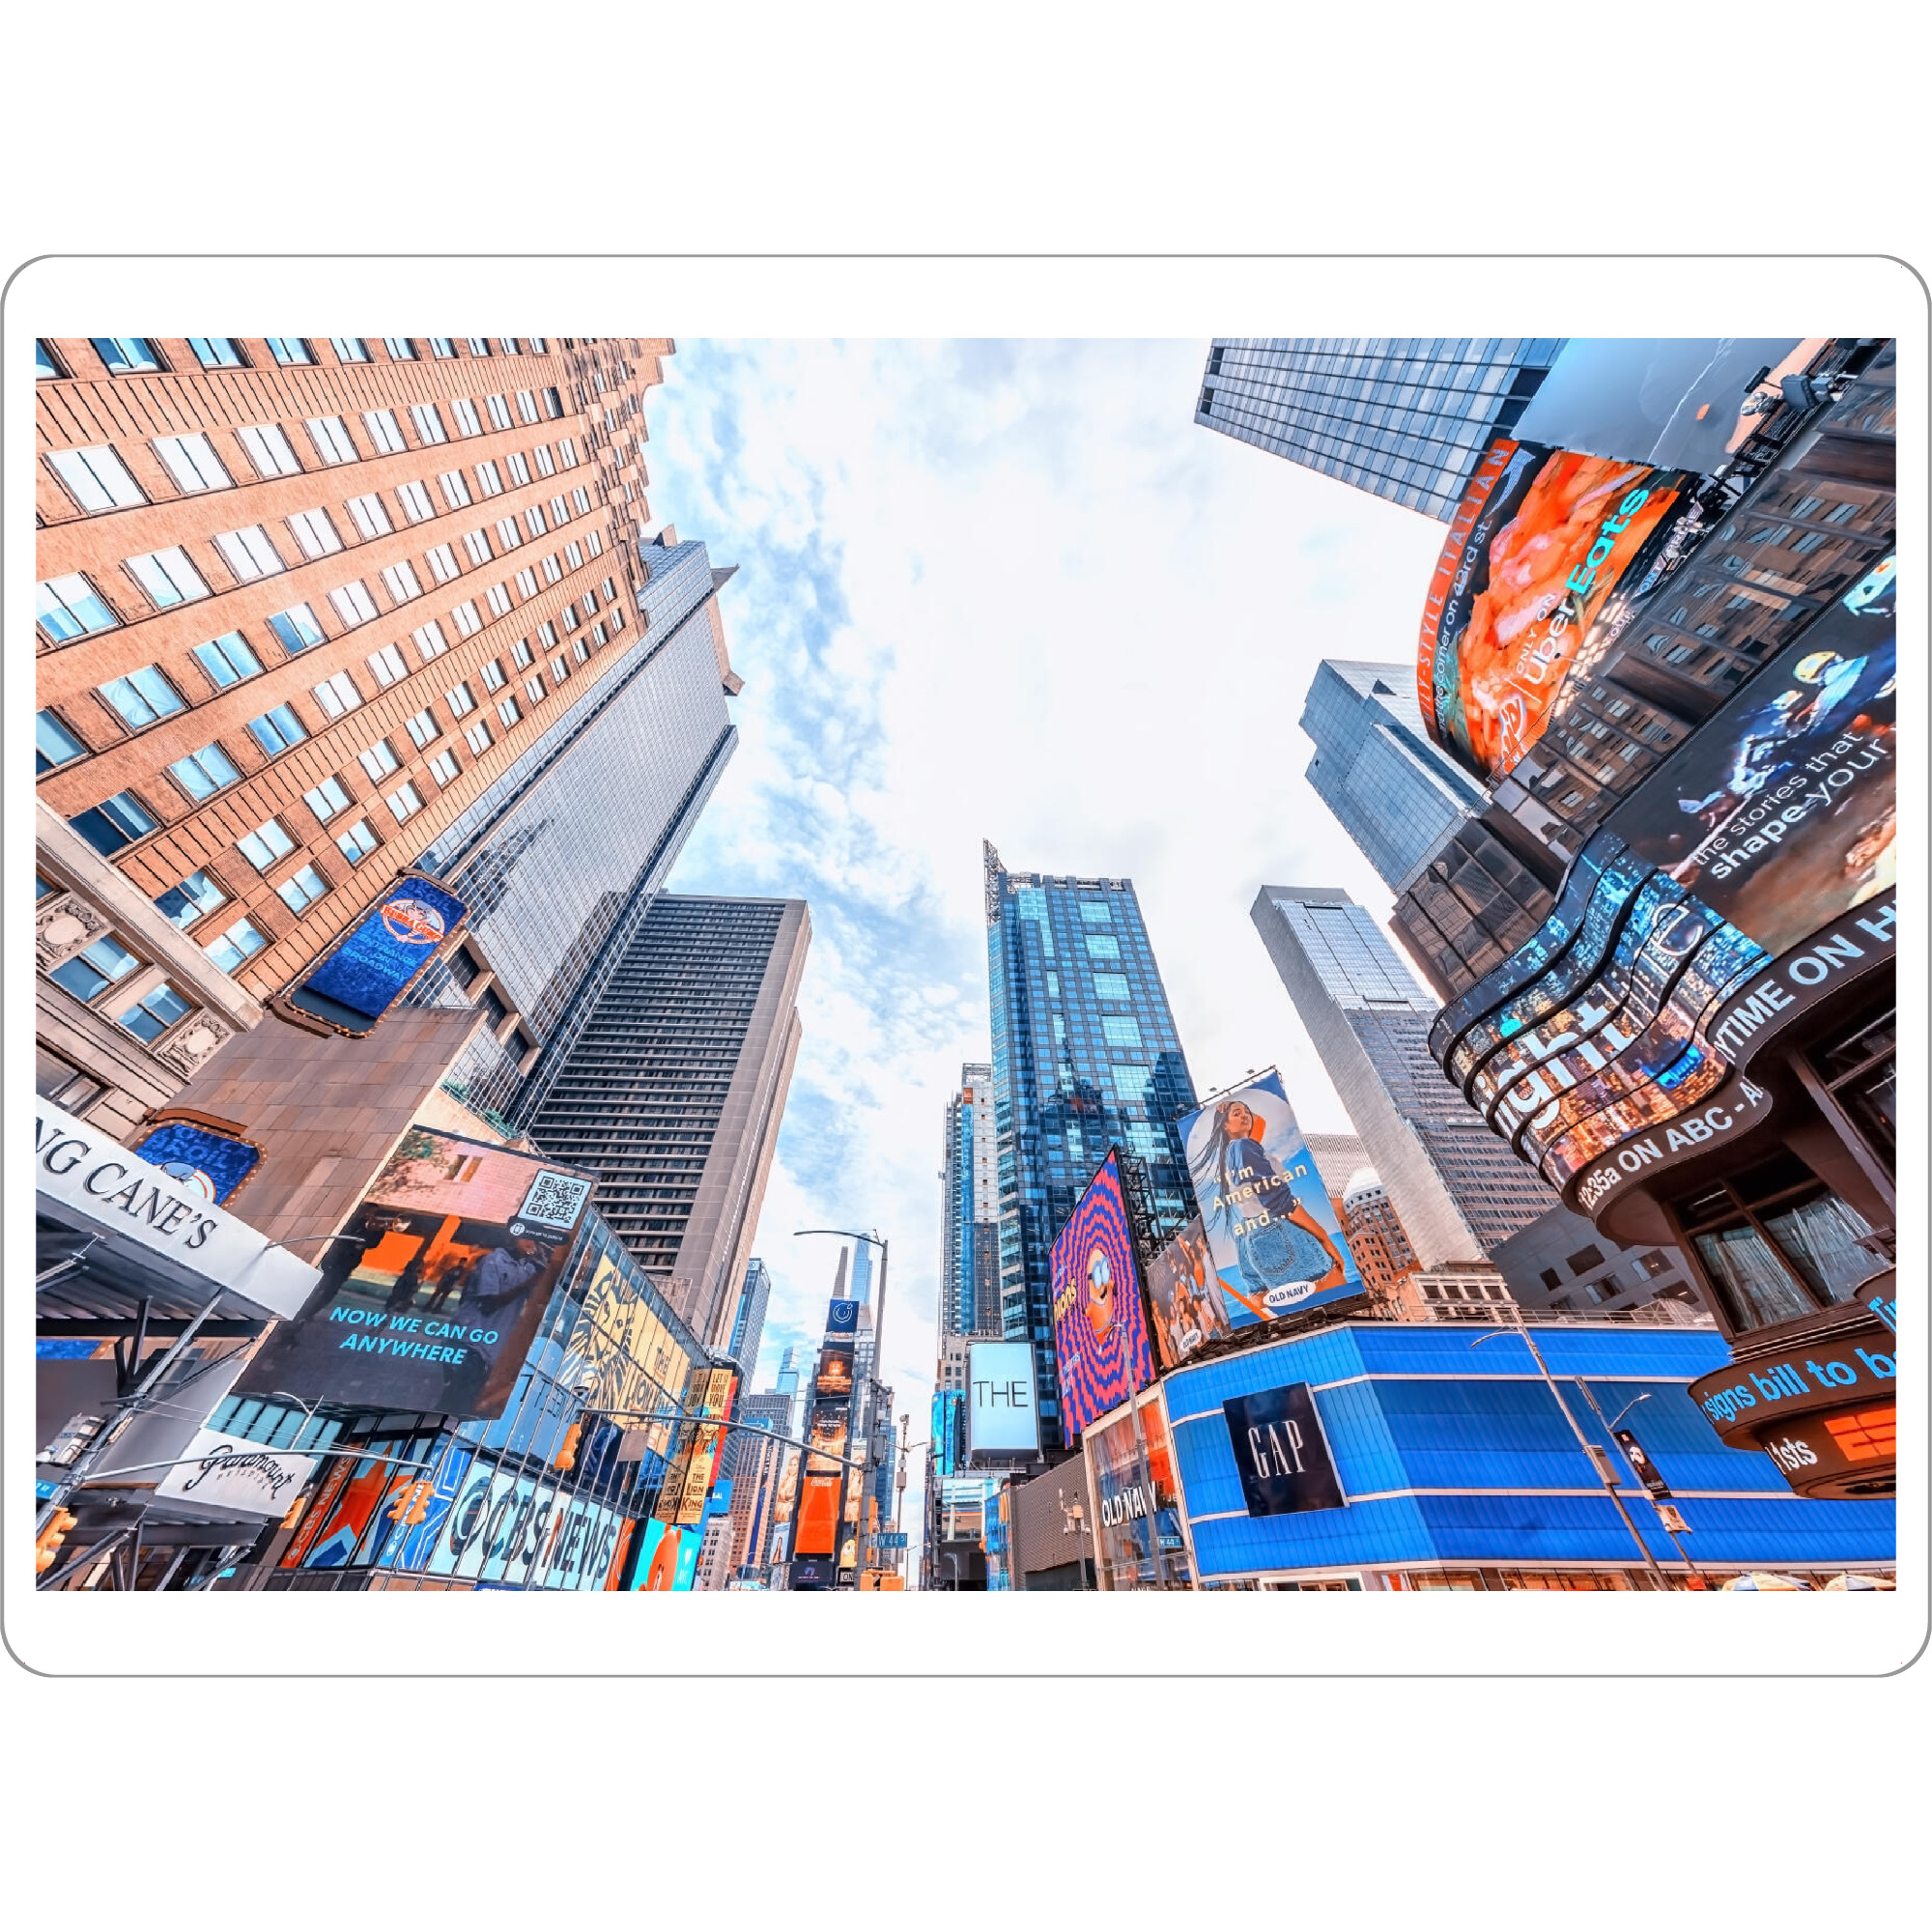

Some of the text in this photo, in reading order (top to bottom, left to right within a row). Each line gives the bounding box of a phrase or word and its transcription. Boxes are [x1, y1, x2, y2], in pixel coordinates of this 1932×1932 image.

[1436, 449, 1511, 576] ITALIAN
[1453, 547, 1479, 596] 43rd
[1524, 489, 1650, 685] Uber Eats
[1445, 600, 1460, 626] on
[1516, 592, 1556, 674] ONLY ON
[1434, 624, 1457, 683] corner
[1691, 731, 1864, 866] the stories that
[1710, 738, 1889, 880] shape your
[1714, 899, 1896, 1065] YTIME ON H
[1617, 1138, 1664, 1173] ON
[1664, 1106, 1734, 1152] ABC
[1739, 1078, 1764, 1108] A
[83, 1161, 219, 1249] CANE’S
[1212, 1163, 1309, 1211] American
[1268, 1284, 1310, 1304] OLD NAVY
[328, 1306, 499, 1345] NOW WE CAN GO
[339, 1333, 469, 1365] ANYWHERE
[973, 1380, 1030, 1407] THE
[1703, 1348, 1896, 1422] signs bill to b
[183, 1444, 295, 1500] Paramount
[1247, 1419, 1306, 1479] GAP
[298, 1457, 353, 1548] CBS NEWS
[680, 1496, 703, 1512] KING
[686, 1483, 704, 1496] LION
[1101, 1493, 1123, 1527] OLD
[482, 1488, 553, 1567] CBS
[540, 1506, 618, 1579] NEWS
[878, 1534, 887, 1547] W
[889, 1534, 899, 1545] 44
[842, 1573, 855, 1581] ON
